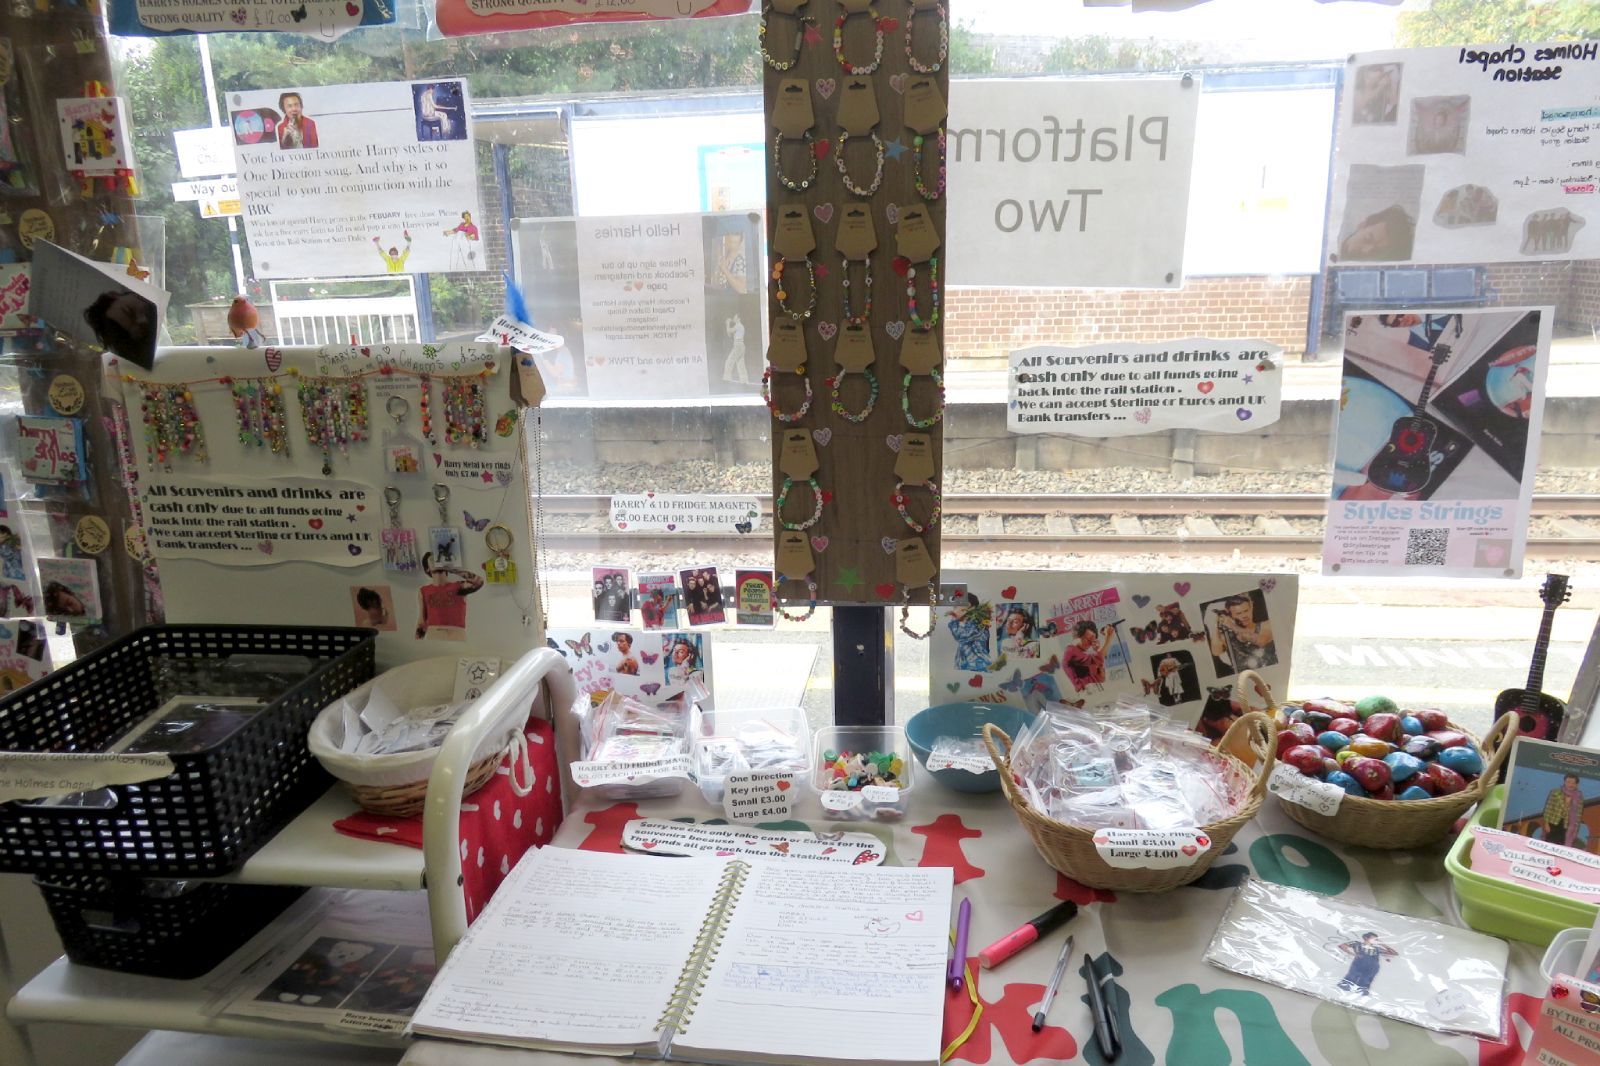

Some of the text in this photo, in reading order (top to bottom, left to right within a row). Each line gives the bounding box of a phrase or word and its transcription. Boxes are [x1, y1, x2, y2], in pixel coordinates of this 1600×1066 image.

[140, 10, 225, 24] STRONG QUALITY
[242, 153, 267, 165] Vote
[270, 151, 286, 163] for
[290, 151, 313, 165] your
[317, 147, 361, 160] favourite
[366, 144, 399, 158] Harry
[403, 143, 433, 157] styles
[244, 170, 268, 182] One
[272, 167, 321, 180] Direction
[356, 163, 380, 175] And
[383, 162, 407, 176] why
[410, 162, 418, 171] is
[190, 184, 215, 195] Way
[245, 176, 453, 202] special to you conjunction with the
[248, 203, 274, 216] BBC
[1019, 350, 1269, 367] All Souvenirs and drinks are
[1061, 368, 1238, 383] only due to all funds going
[1018, 384, 1175, 397] back into the rail station
[1017, 395, 1269, 410] We can accept Sterling or Euros and UK
[1017, 411, 1111, 423] Bank transfers
[148, 485, 366, 500] All Souvenirs and drinks are
[150, 501, 343, 518] cash only due to all funds going
[613, 499, 647, 509] HARRY
[658, 500, 670, 509] 1D
[672, 500, 707, 510] FRIDGE
[709, 500, 757, 510] MAGNETS
[643, 514, 669, 523] EACH
[671, 514, 685, 523] OR
[687, 514, 693, 523] 3
[696, 514, 714, 523] FOR
[1344, 502, 1503, 525] Styles Strings
[152, 516, 289, 528] back into the rail station
[153, 528, 372, 541] We can accept Sterling or Euros and UK
[157, 539, 238, 551] Bank transfers
[15, 779, 55, 789] Holmes
[730, 772, 793, 783] One Direction
[731, 785, 775, 796] Key rings
[732, 795, 786, 807] Small £3.00
[733, 806, 787, 819] Large £4.00
[634, 829, 735, 845] souvenirs because
[640, 821, 668, 831] Sorry
[709, 829, 732, 838] only
[734, 832, 758, 840] take
[803, 838, 835, 846] Euros
[855, 841, 875, 849] the
[630, 835, 649, 844] The
[651, 837, 681, 846] funds
[683, 840, 699, 849] all
[716, 845, 743, 853] back
[745, 848, 767, 856] into
[769, 850, 788, 858] the
[790, 852, 830, 862] station
[1110, 849, 1178, 859] Large £4.00
[1528, 839, 1573, 858] HOLMES
[1503, 850, 1554, 866] VILLAGE
[1512, 865, 1564, 888] OFFICIAL
[1547, 1007, 1586, 1024] BY THE
[1554, 1025, 1575, 1040] ALL
[1539, 1053, 1547, 1062] 3
